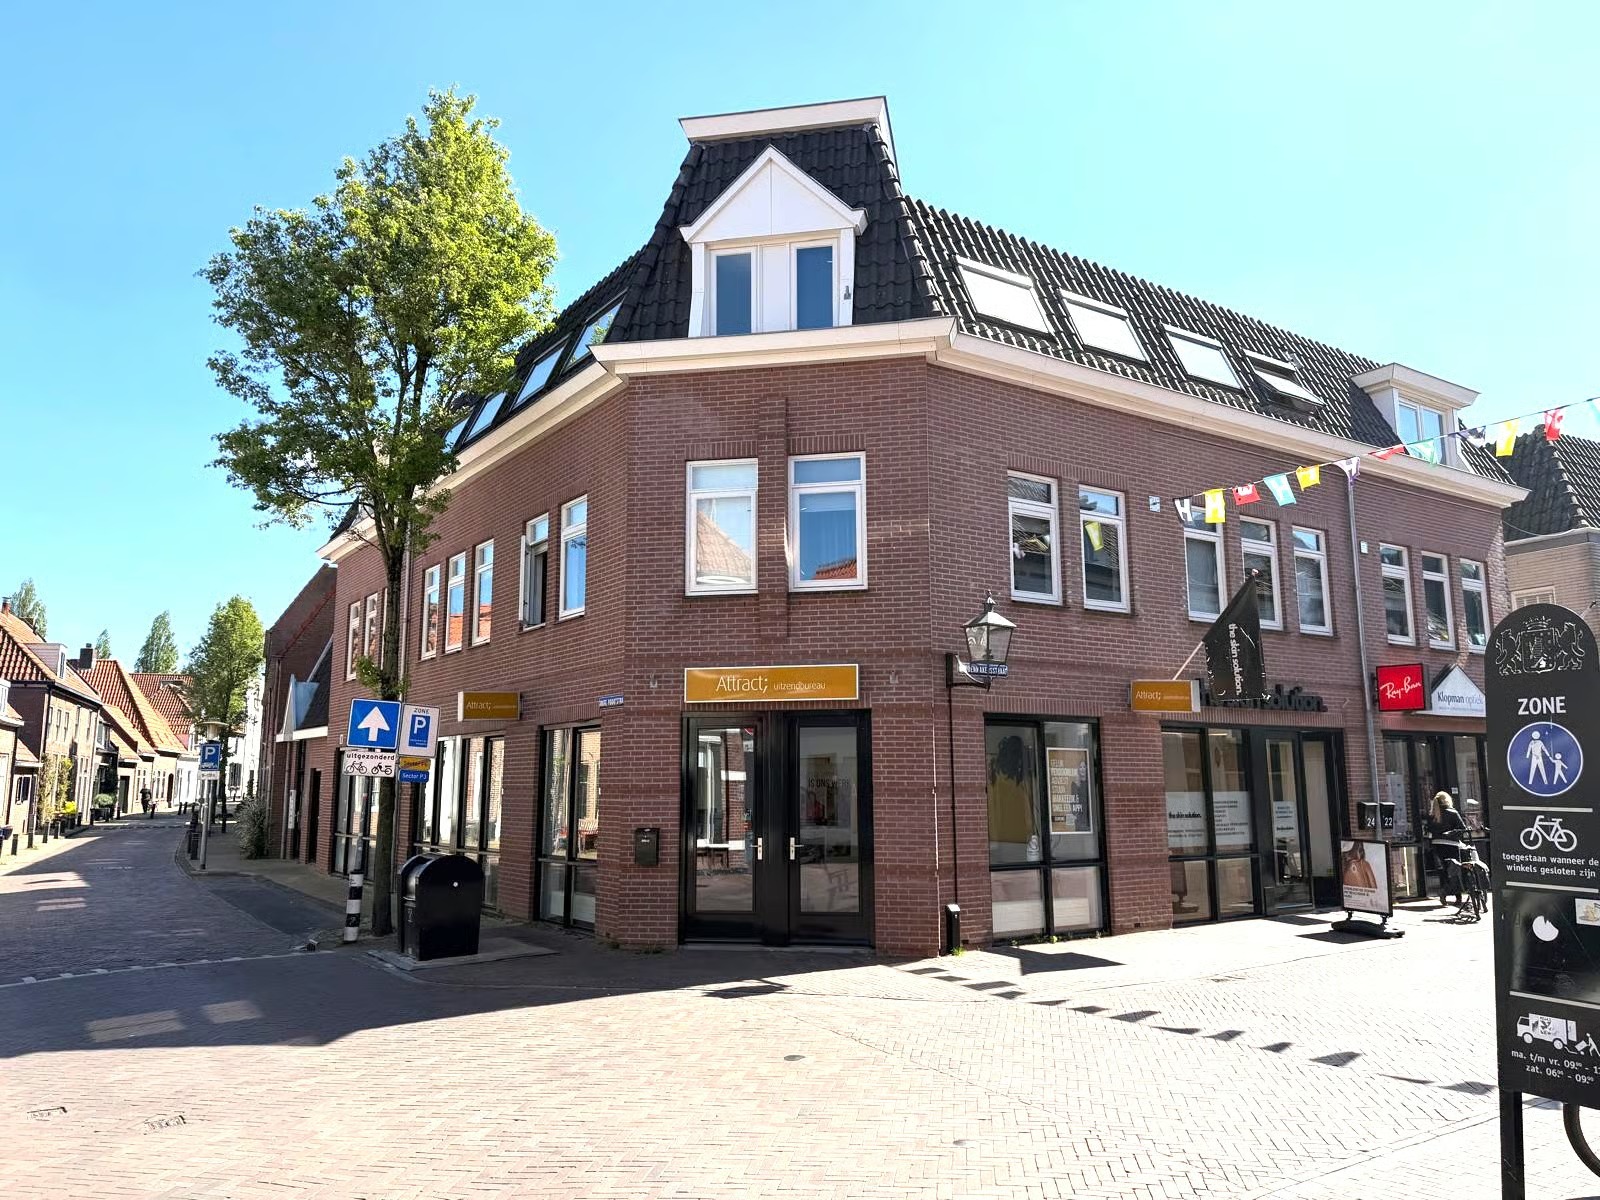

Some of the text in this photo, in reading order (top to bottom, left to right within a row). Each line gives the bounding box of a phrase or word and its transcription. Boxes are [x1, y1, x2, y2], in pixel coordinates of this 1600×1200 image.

[1174, 497, 1193, 522] H
[1228, 623, 1238, 638] the
[1230, 638, 1241, 658] skin
[773, 681, 826, 691] uitzendbureau
[1380, 676, 1422, 699] Ray-Ban
[1437, 691, 1464, 706] Klopman
[1517, 696, 1567, 715] ZONE
[413, 707, 430, 715] ZONE
[413, 716, 427, 734] P
[205, 747, 215, 759] P
[346, 753, 395, 762] uitgezonderd
[1176, 811, 1184, 819] skin
[1384, 817, 1393, 827] 22
[1367, 818, 1376, 827] 24
[1502, 852, 1600, 866] toegestaan wanneer de
[1506, 864, 1596, 879] winkels gesloten zijn
[1511, 1050, 1527, 1060] ma.
[1529, 1053, 1546, 1063] t/m
[1548, 1058, 1561, 1067] vr.
[1526, 1065, 1543, 1074] zat.
